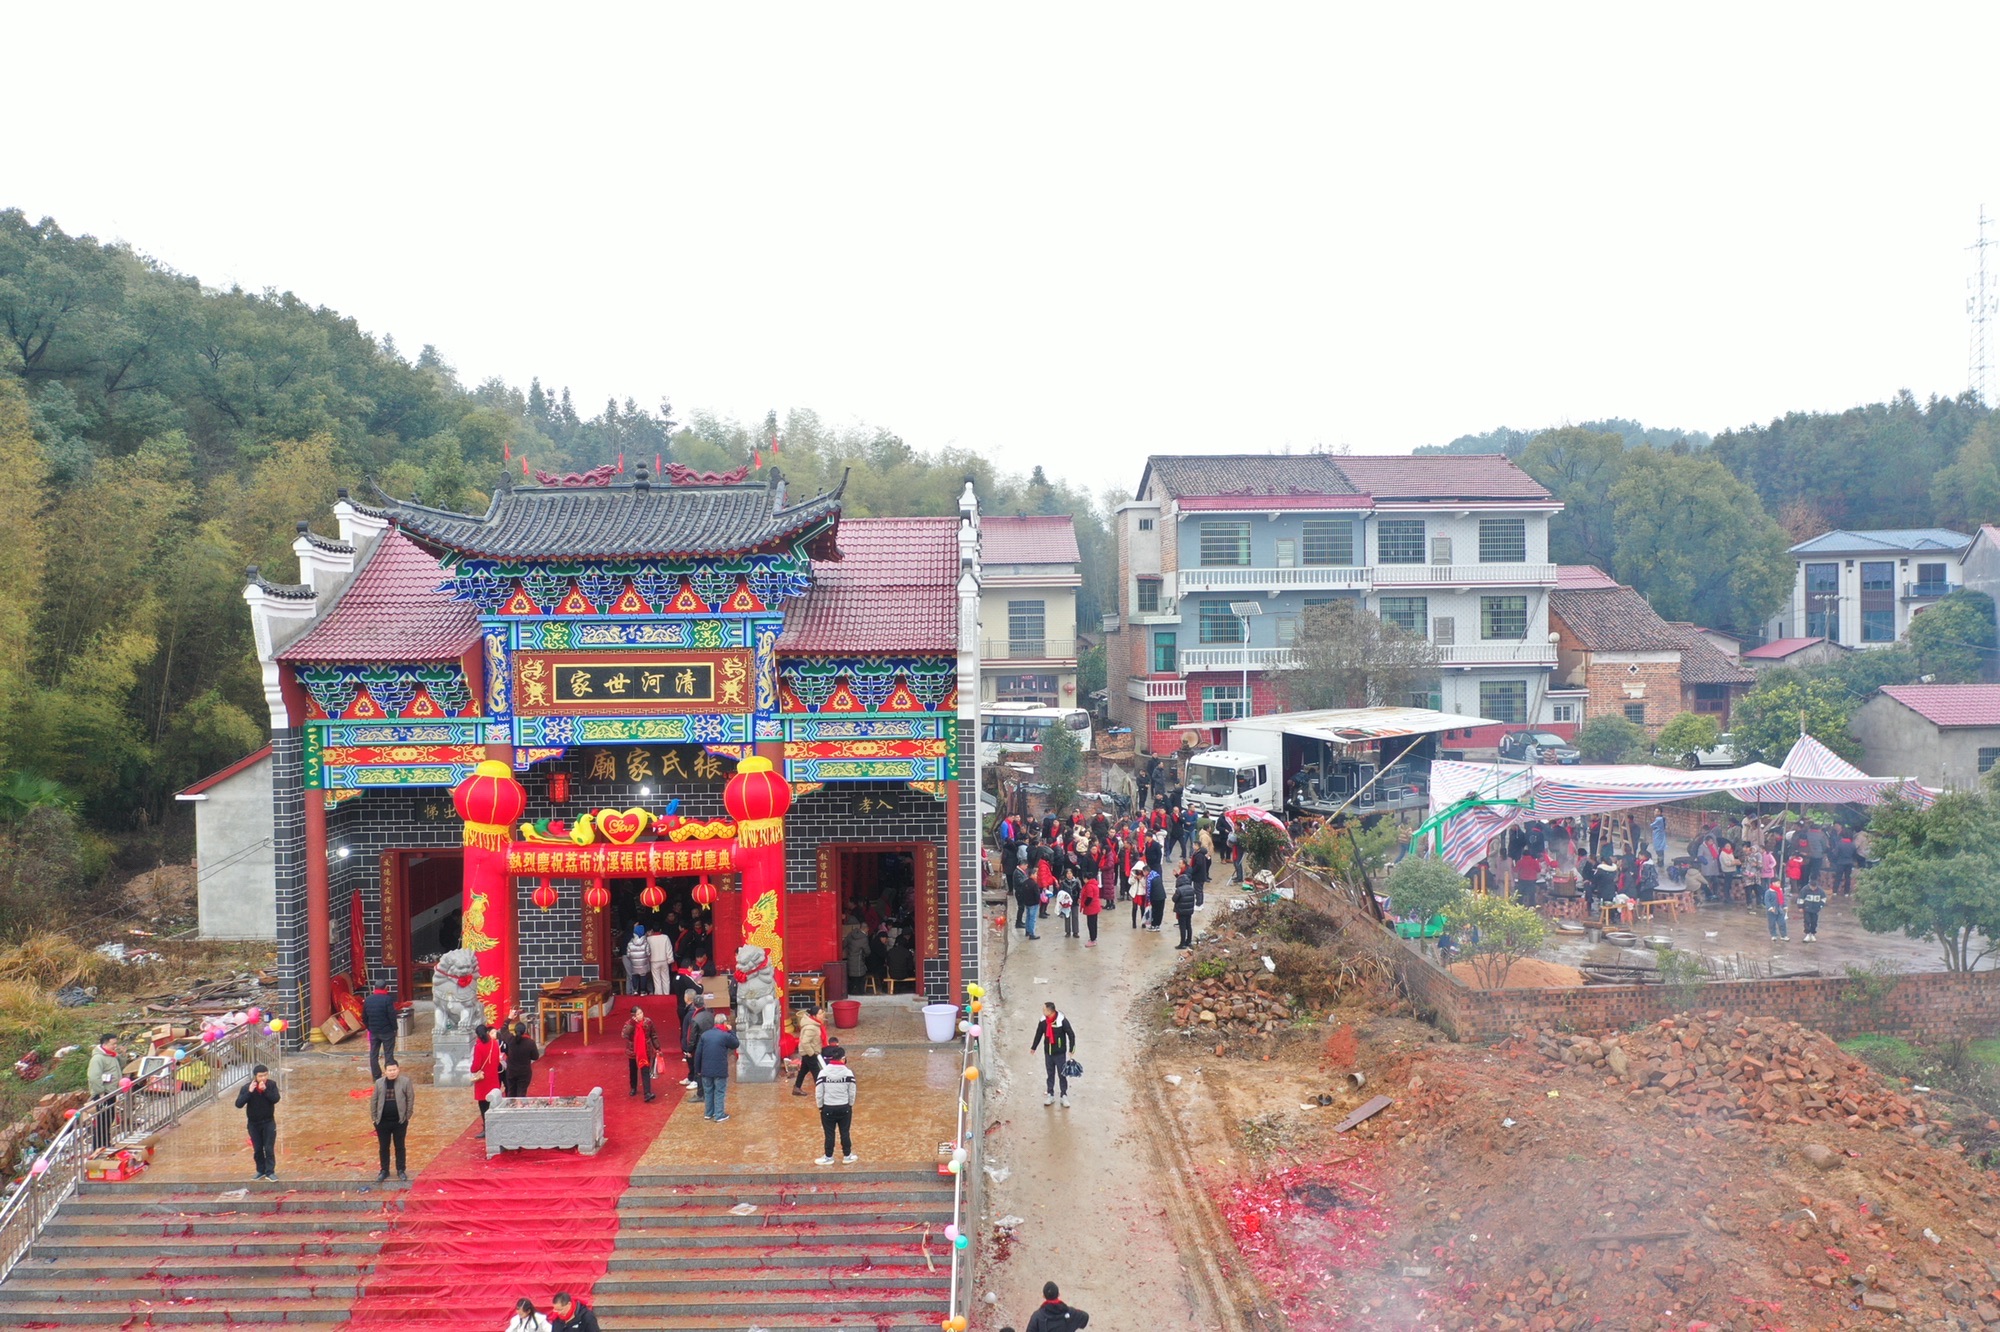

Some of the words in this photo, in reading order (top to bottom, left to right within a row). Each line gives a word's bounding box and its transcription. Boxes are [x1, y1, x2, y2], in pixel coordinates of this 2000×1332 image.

[570, 669, 697, 697] 清河世家
[588, 747, 723, 782] 張氏家廟
[858, 796, 893, 814] 入孝
[609, 819, 636, 834] Love
